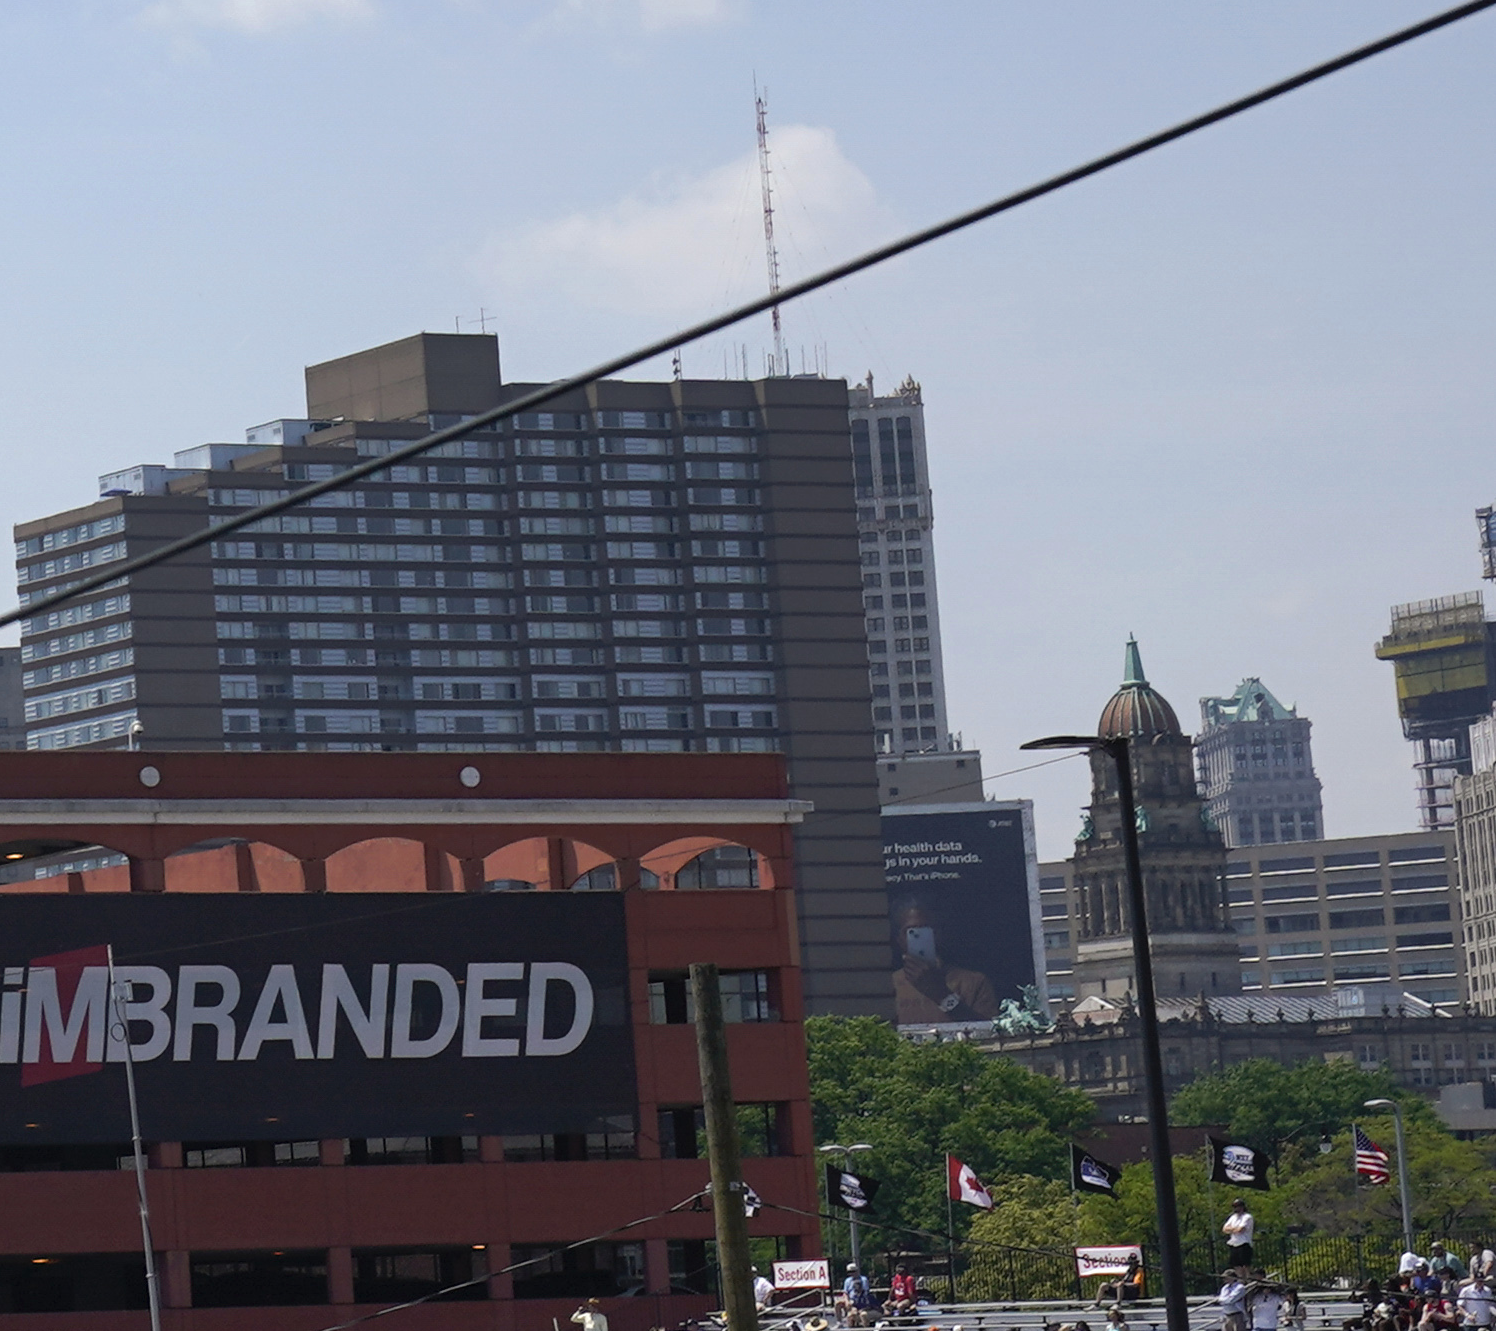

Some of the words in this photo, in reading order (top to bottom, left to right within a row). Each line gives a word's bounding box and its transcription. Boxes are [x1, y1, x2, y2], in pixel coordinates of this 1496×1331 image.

[895, 842, 933, 853] health
[935, 841, 962, 852] data
[898, 856, 910, 867] in
[911, 856, 938, 868] your
[941, 853, 982, 864] hands.
[778, 1268, 811, 1282] Section
[819, 1269, 827, 1280] A
